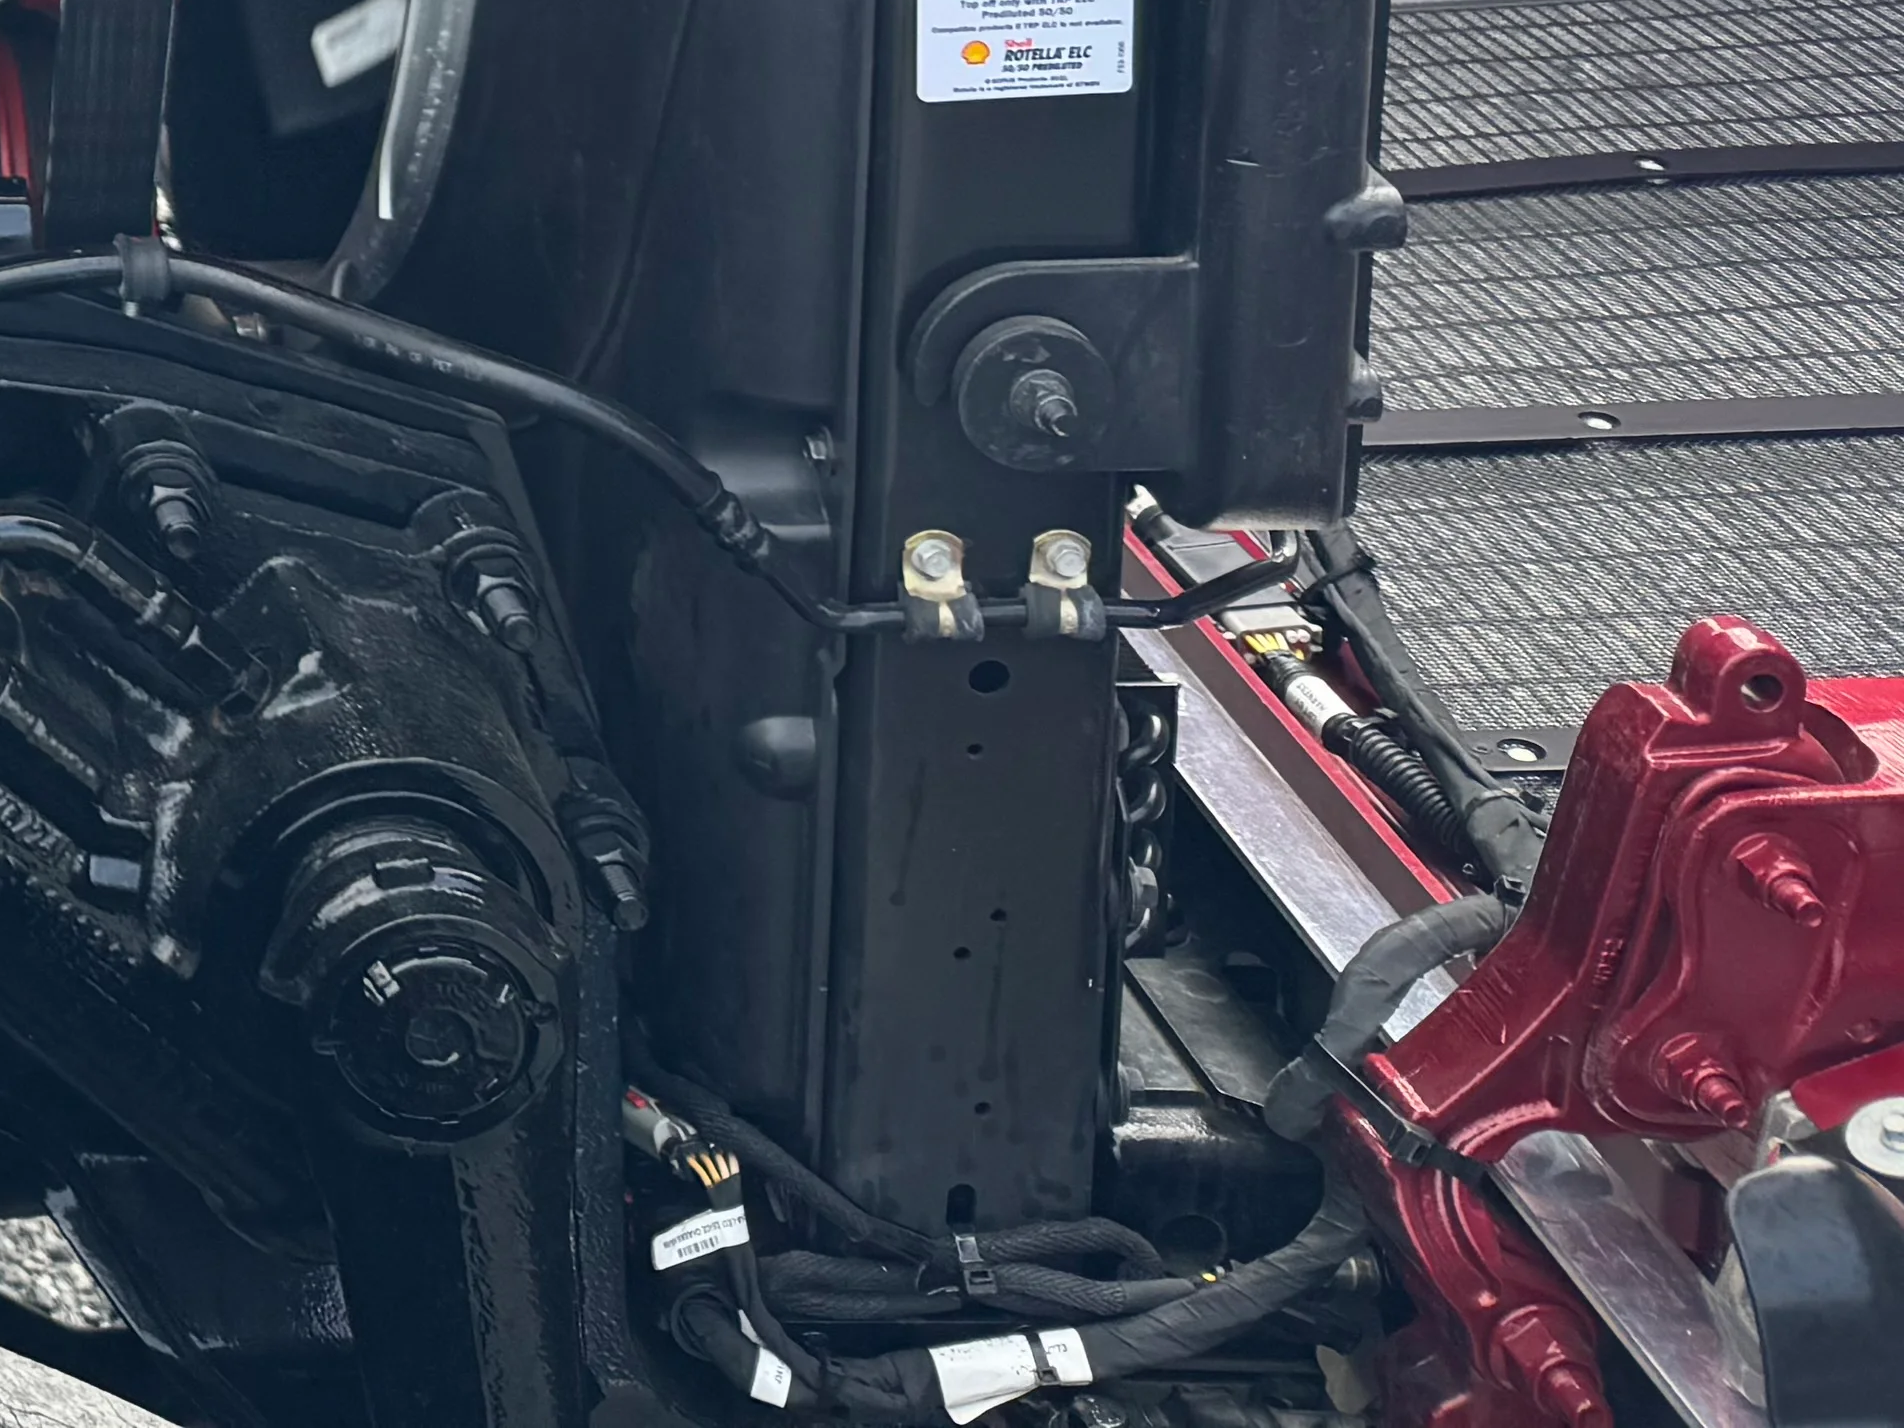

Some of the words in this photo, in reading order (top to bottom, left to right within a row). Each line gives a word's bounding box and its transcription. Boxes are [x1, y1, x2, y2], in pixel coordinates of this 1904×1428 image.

[960, 0, 979, 10] Top
[982, 0, 996, 8] off
[982, 9, 1035, 19] Prediluted
[1068, 45, 1092, 59] ELC
